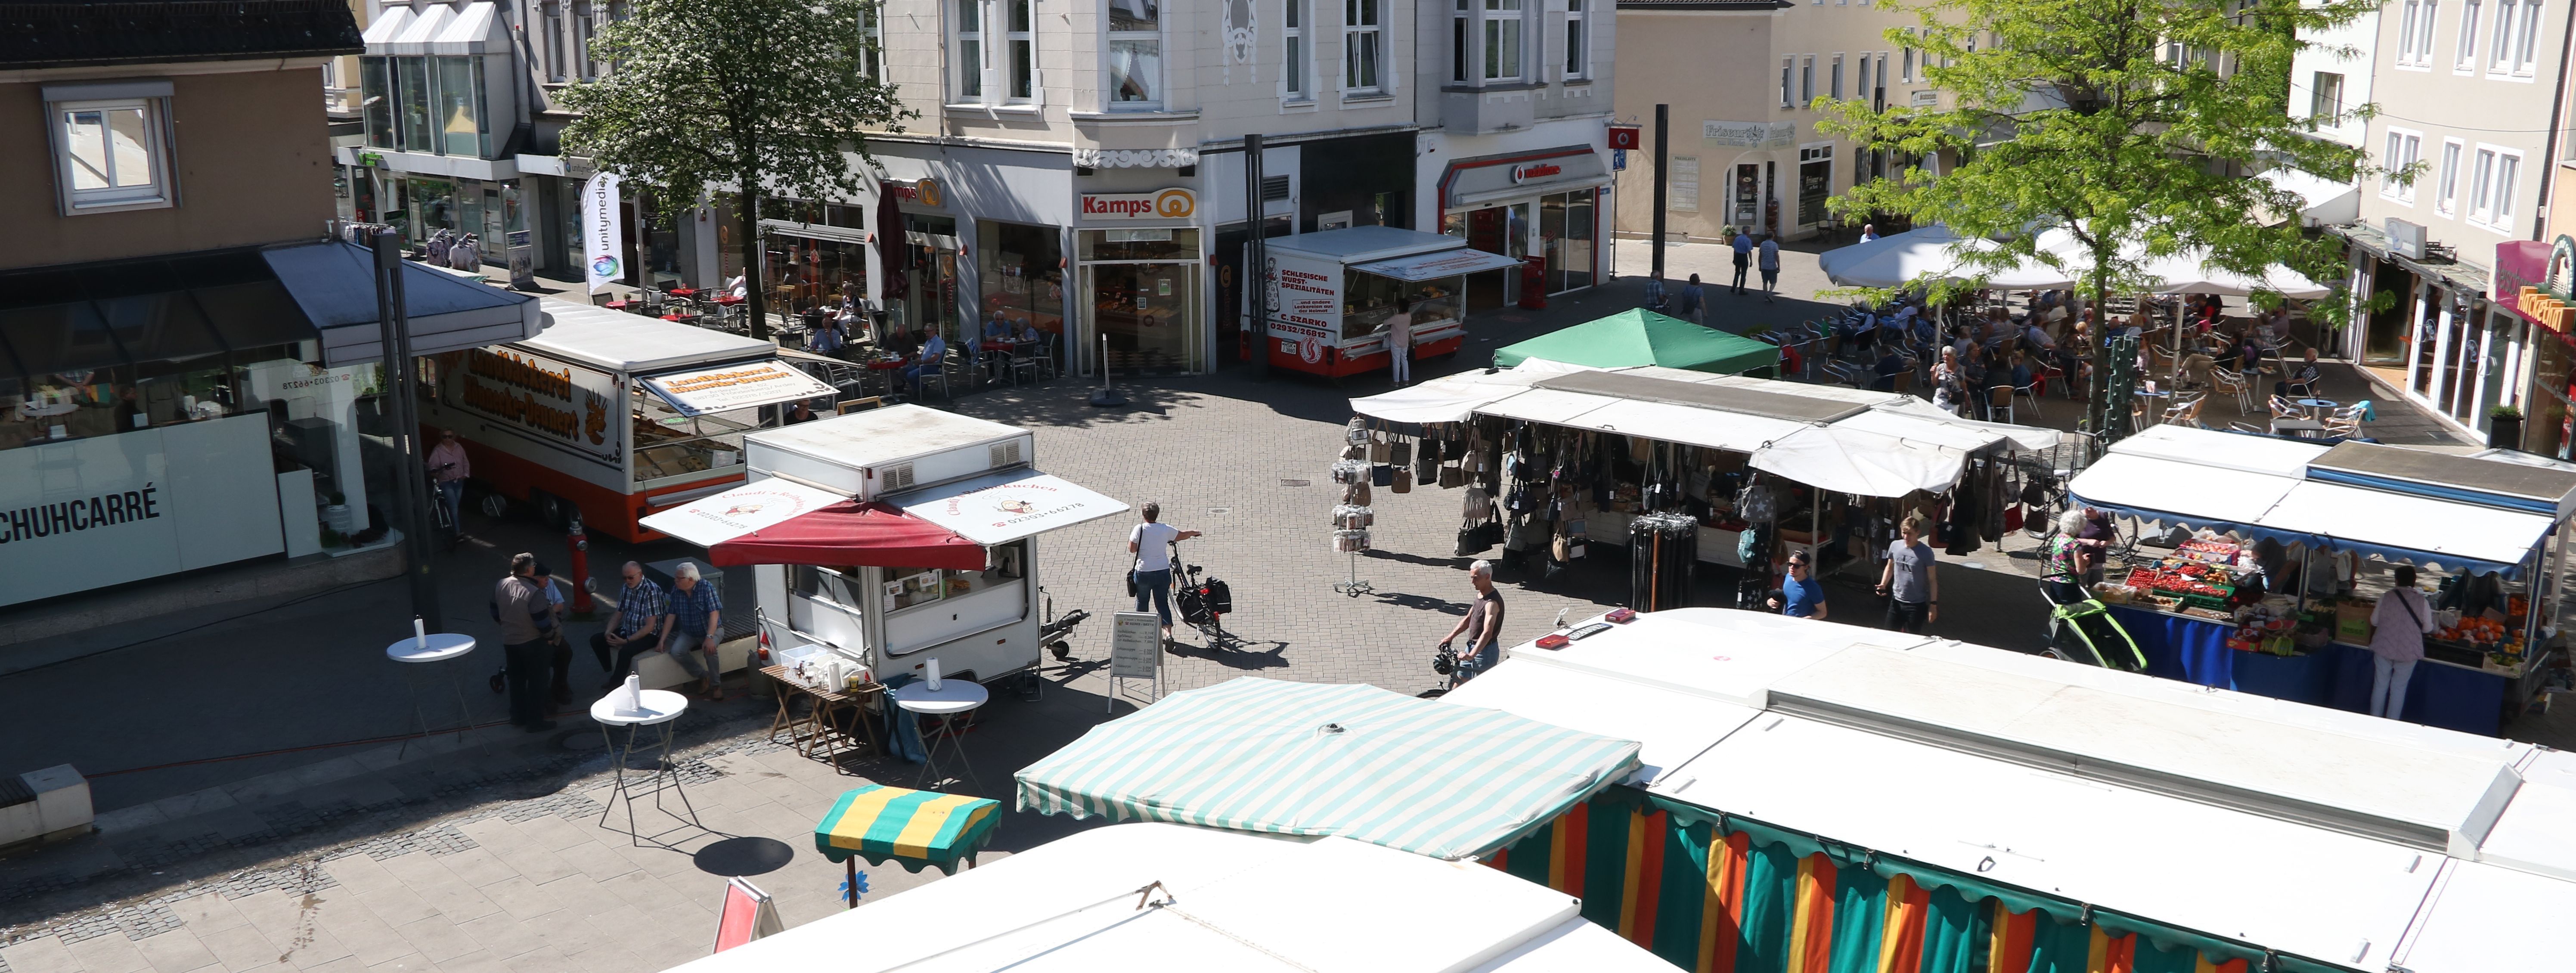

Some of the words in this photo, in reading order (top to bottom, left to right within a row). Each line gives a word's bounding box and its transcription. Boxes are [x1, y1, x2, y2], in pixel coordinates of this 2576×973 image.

[1706, 124, 1745, 138] Friseur
[572, 164, 595, 175] unitymed
[1525, 164, 1561, 178] vodafone
[595, 176, 611, 251] unitymedia
[1083, 196, 1151, 217] Kamps
[1282, 270, 1328, 282] SCHLESISCHE
[1282, 276, 1307, 285] WURST-
[1281, 282, 1334, 296] SPEZIALITÄTEN
[1290, 315, 1327, 327] SZARKO
[1271, 322, 1326, 338] 02932/26812
[468, 349, 572, 403] Landbäckerei
[665, 367, 777, 387] Landbäckerei
[0, 482, 160, 544] CHUHCARRÉ
